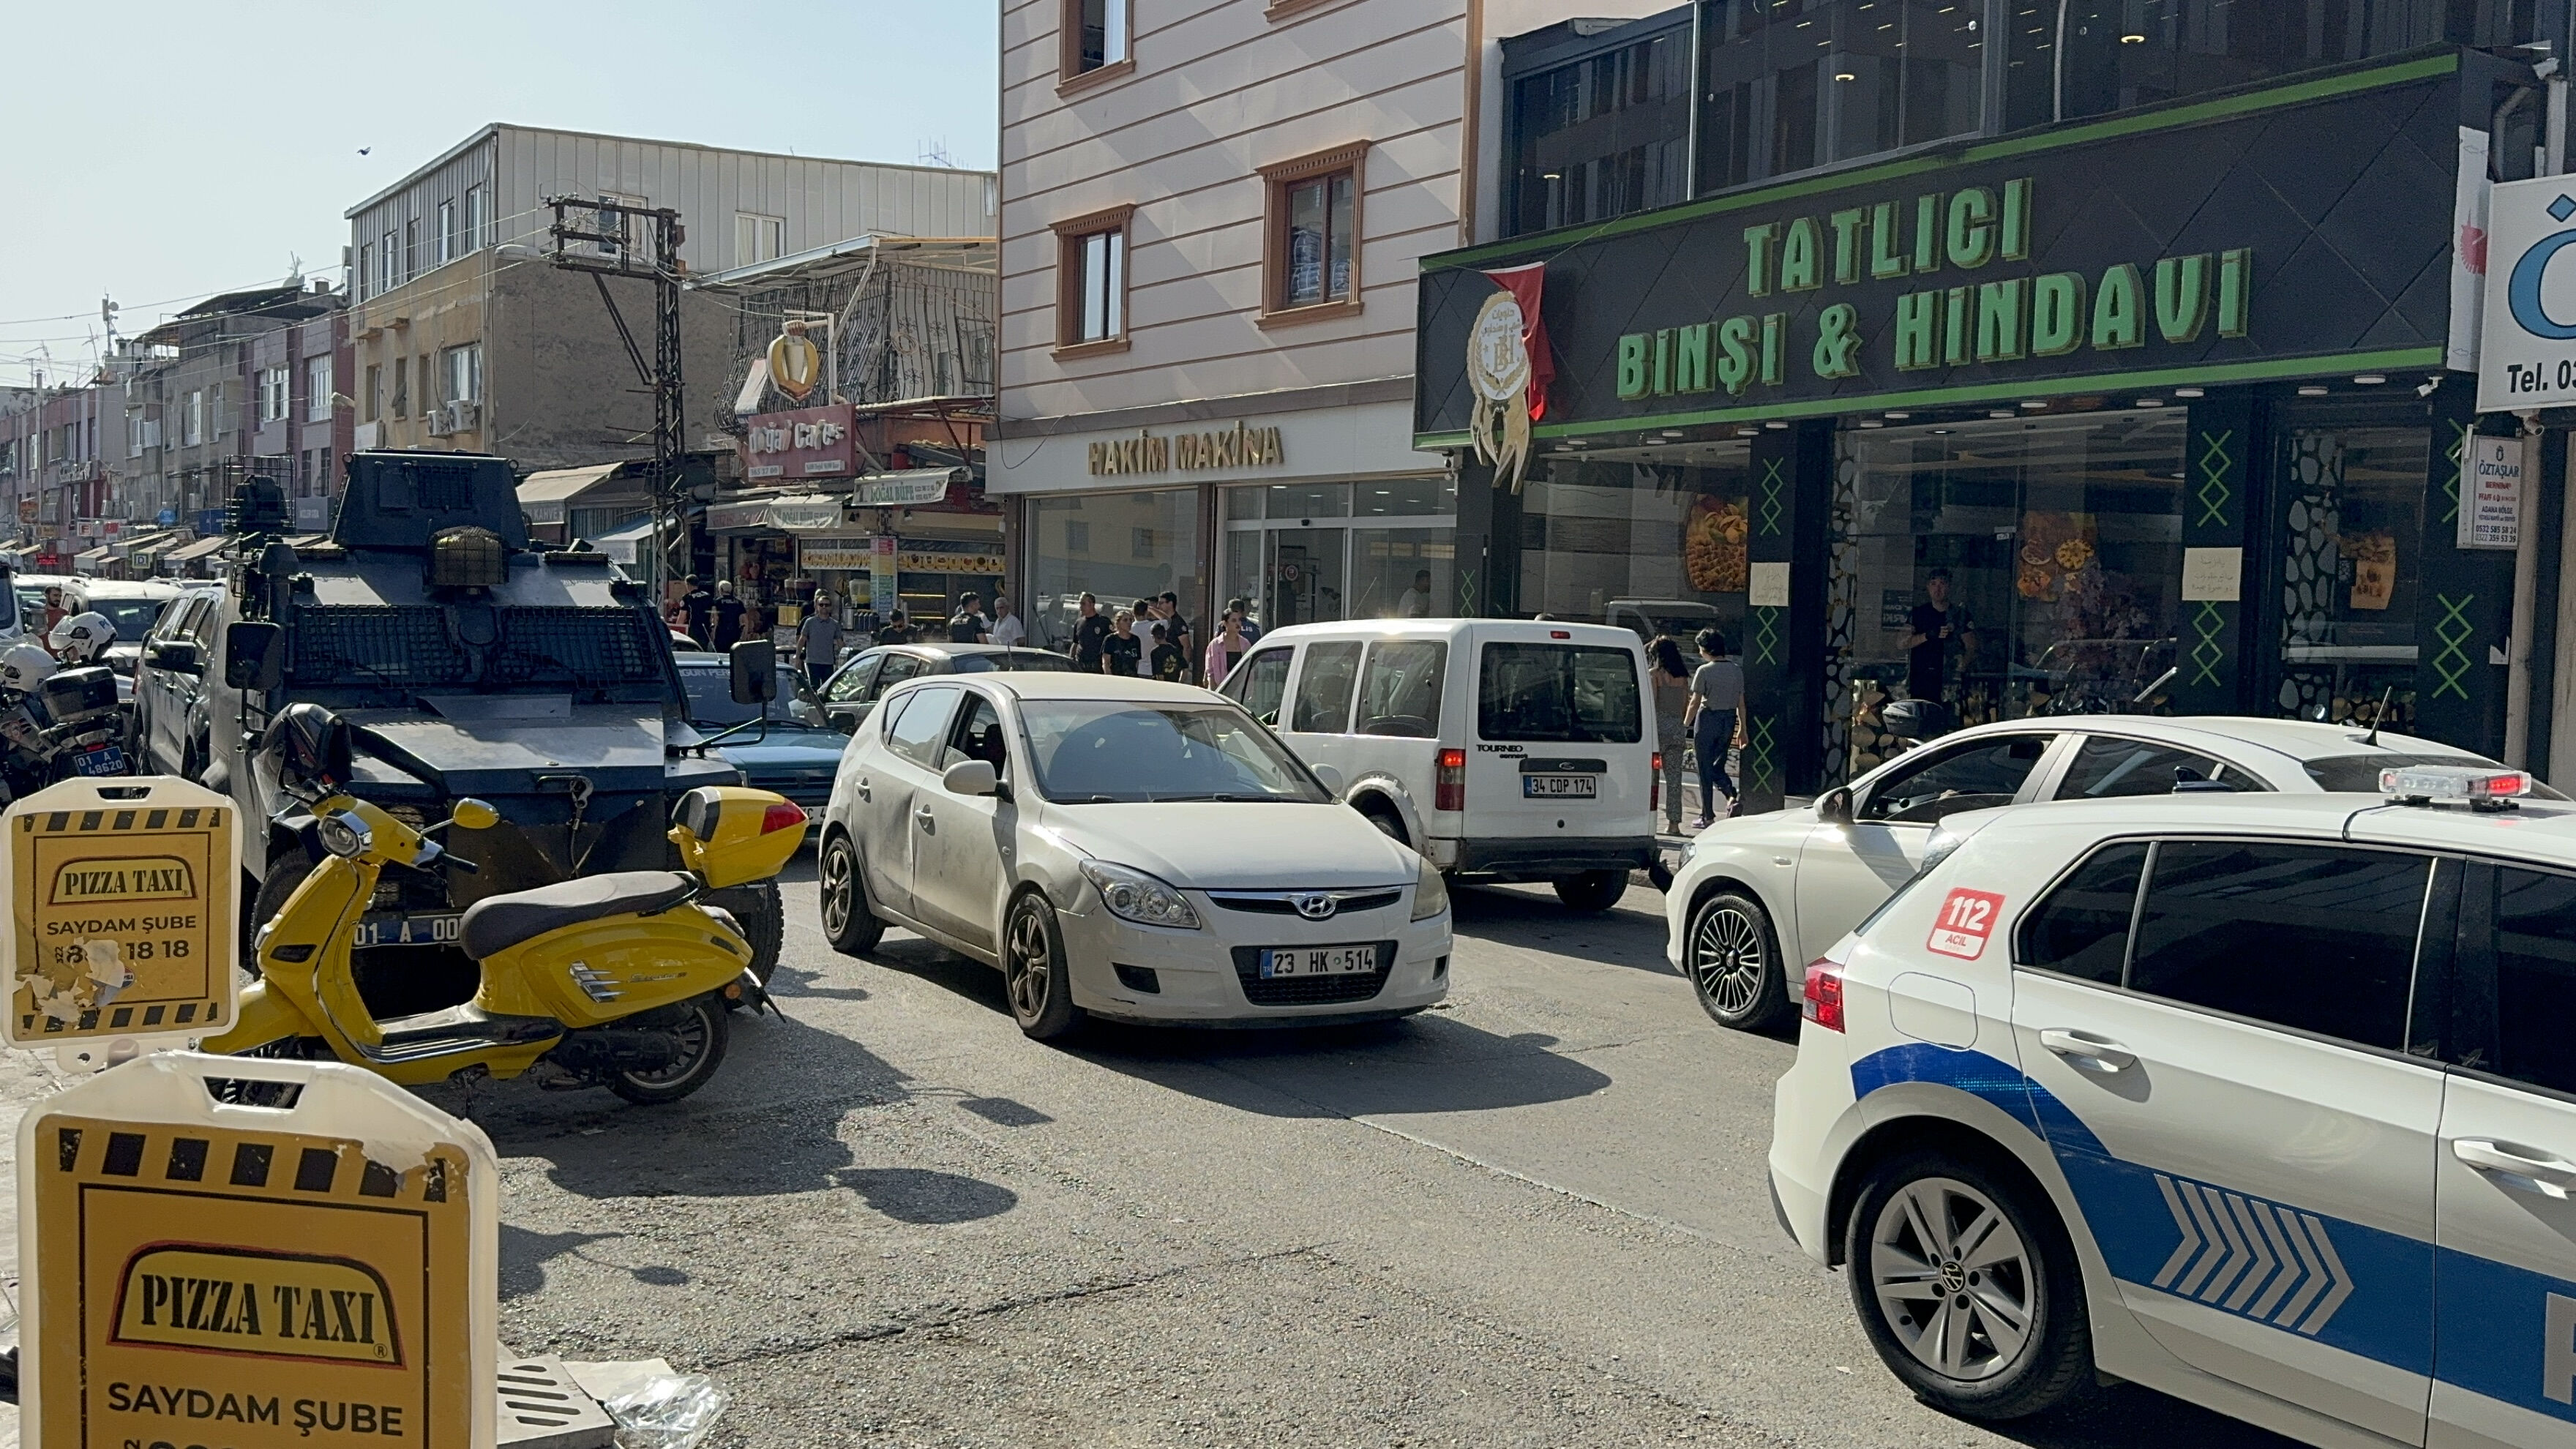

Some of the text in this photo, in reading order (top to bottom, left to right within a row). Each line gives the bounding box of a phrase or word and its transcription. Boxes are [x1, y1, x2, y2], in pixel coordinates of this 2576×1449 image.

[1744, 177, 2032, 297] TATLICI
[1813, 303, 1862, 379] &
[2507, 362, 2548, 393] Tel.
[1087, 420, 1284, 476] HAKİM MAKİNA
[2479, 460, 2520, 479] ÖZTAŞLAR
[871, 483, 894, 502] DOĞAL
[78, 751, 112, 767] 01 A
[1476, 744, 1524, 752] TOURNEO
[88, 759, 124, 776] 48620
[1532, 779, 1592, 793] 34 CDP 174
[64, 868, 184, 896] PIZZA TAXI
[47, 916, 197, 936] SAYDAM ŞUBE
[1947, 896, 1991, 932] 112
[354, 923, 378, 946] 01
[399, 921, 412, 943] A
[126, 941, 154, 960] 18
[162, 940, 190, 958] 18
[1274, 954, 1295, 974] 23
[1310, 951, 1329, 973] HK
[1345, 949, 1373, 971] 514
[141, 1273, 375, 1345] PIZZA TAXI
[108, 1382, 403, 1437] SAYDAM ŞUBE
